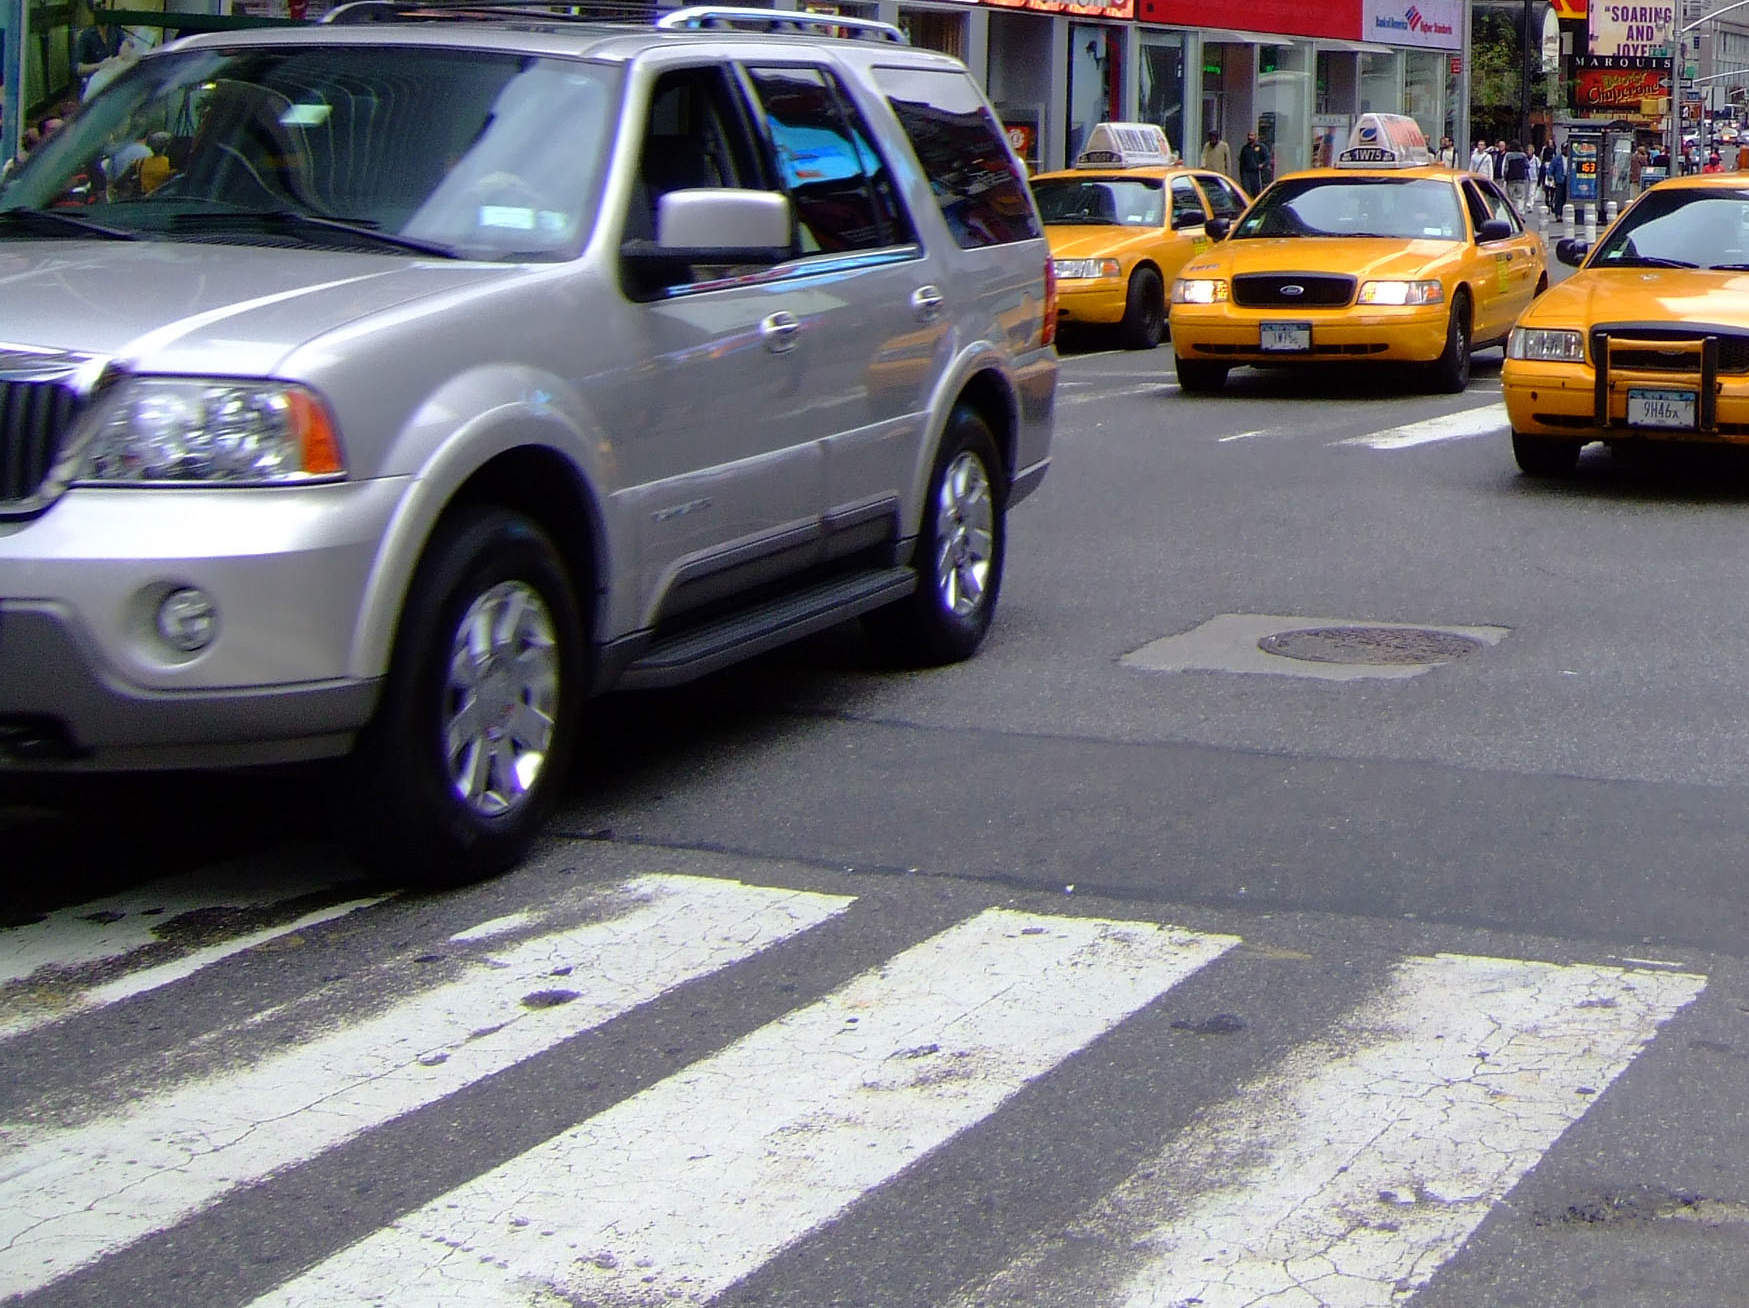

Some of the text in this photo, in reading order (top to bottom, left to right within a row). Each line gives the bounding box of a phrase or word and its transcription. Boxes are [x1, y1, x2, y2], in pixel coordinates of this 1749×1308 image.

[1626, 24, 1654, 42] AND
[1574, 56, 1672, 69] MARQUIS
[1353, 147, 1382, 162] 1W75
